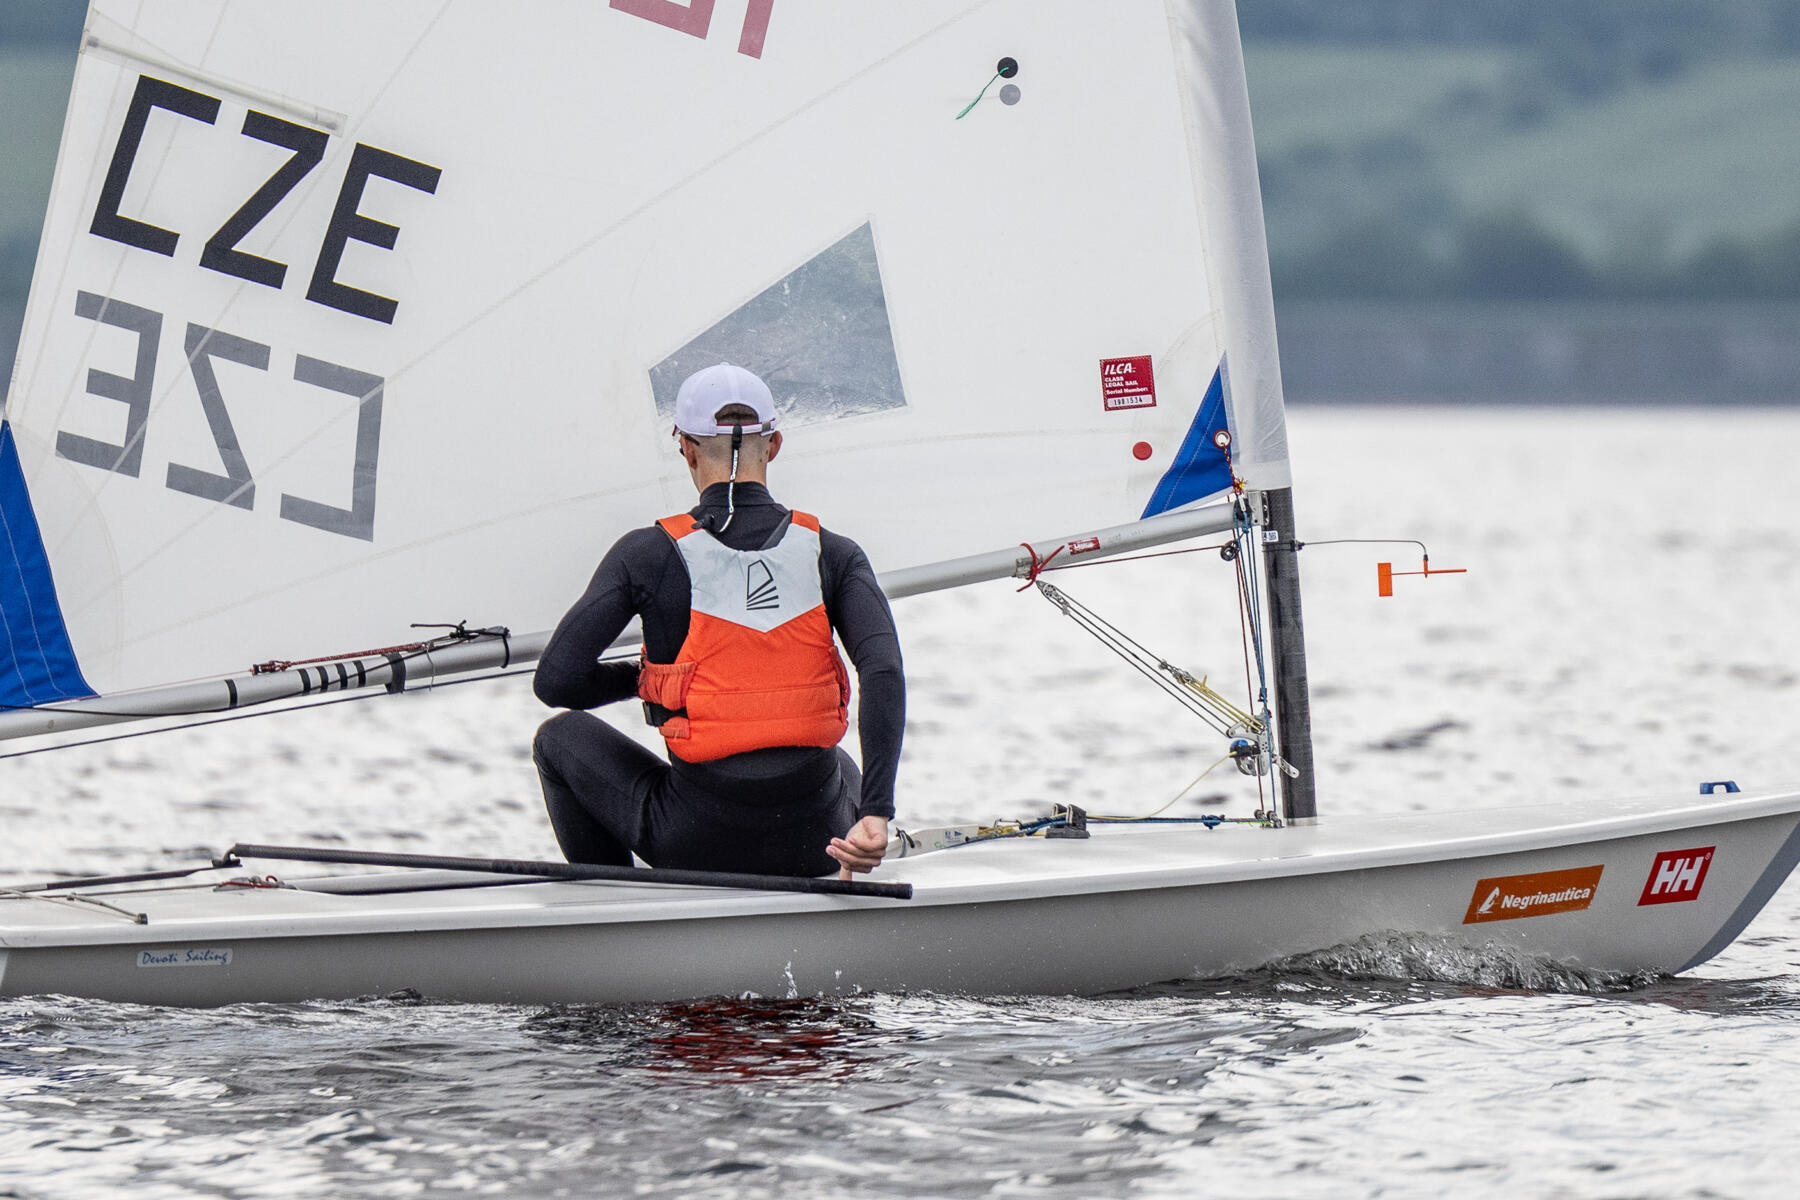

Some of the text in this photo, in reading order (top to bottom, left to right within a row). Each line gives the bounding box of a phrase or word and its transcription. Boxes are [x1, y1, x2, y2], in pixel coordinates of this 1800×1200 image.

[90, 74, 442, 325] CZE
[1104, 362, 1132, 375] ILCA
[1650, 856, 1704, 895] HH
[1501, 884, 1591, 910] Negrinautica
[142, 948, 228, 965] Devoti Sailing
